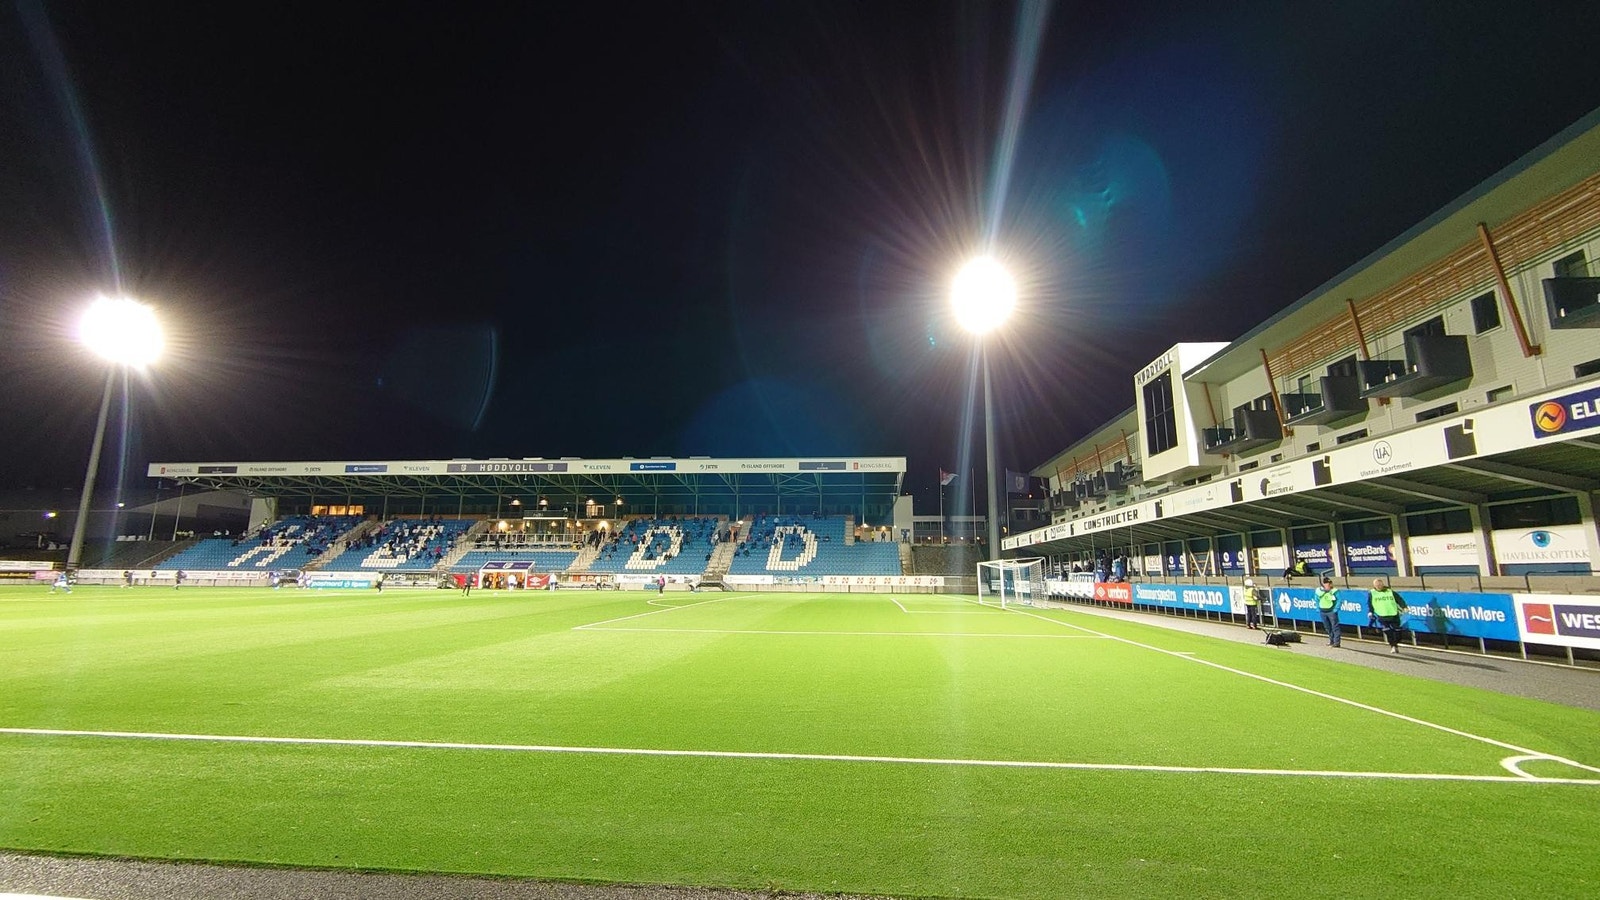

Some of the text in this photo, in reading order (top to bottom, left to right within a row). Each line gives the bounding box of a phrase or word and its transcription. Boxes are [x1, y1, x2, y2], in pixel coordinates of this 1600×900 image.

[479, 464, 534, 472] HØDDVOLL
[1381, 461, 1412, 474] Apartment
[1084, 509, 1138, 530] CONSTRUCTER
[1502, 549, 1590, 560] HAVBLIKK OPTIKK
[1107, 586, 1129, 599] umbro
[1183, 589, 1223, 608] smp.no
[1471, 606, 1506, 622] Møre
